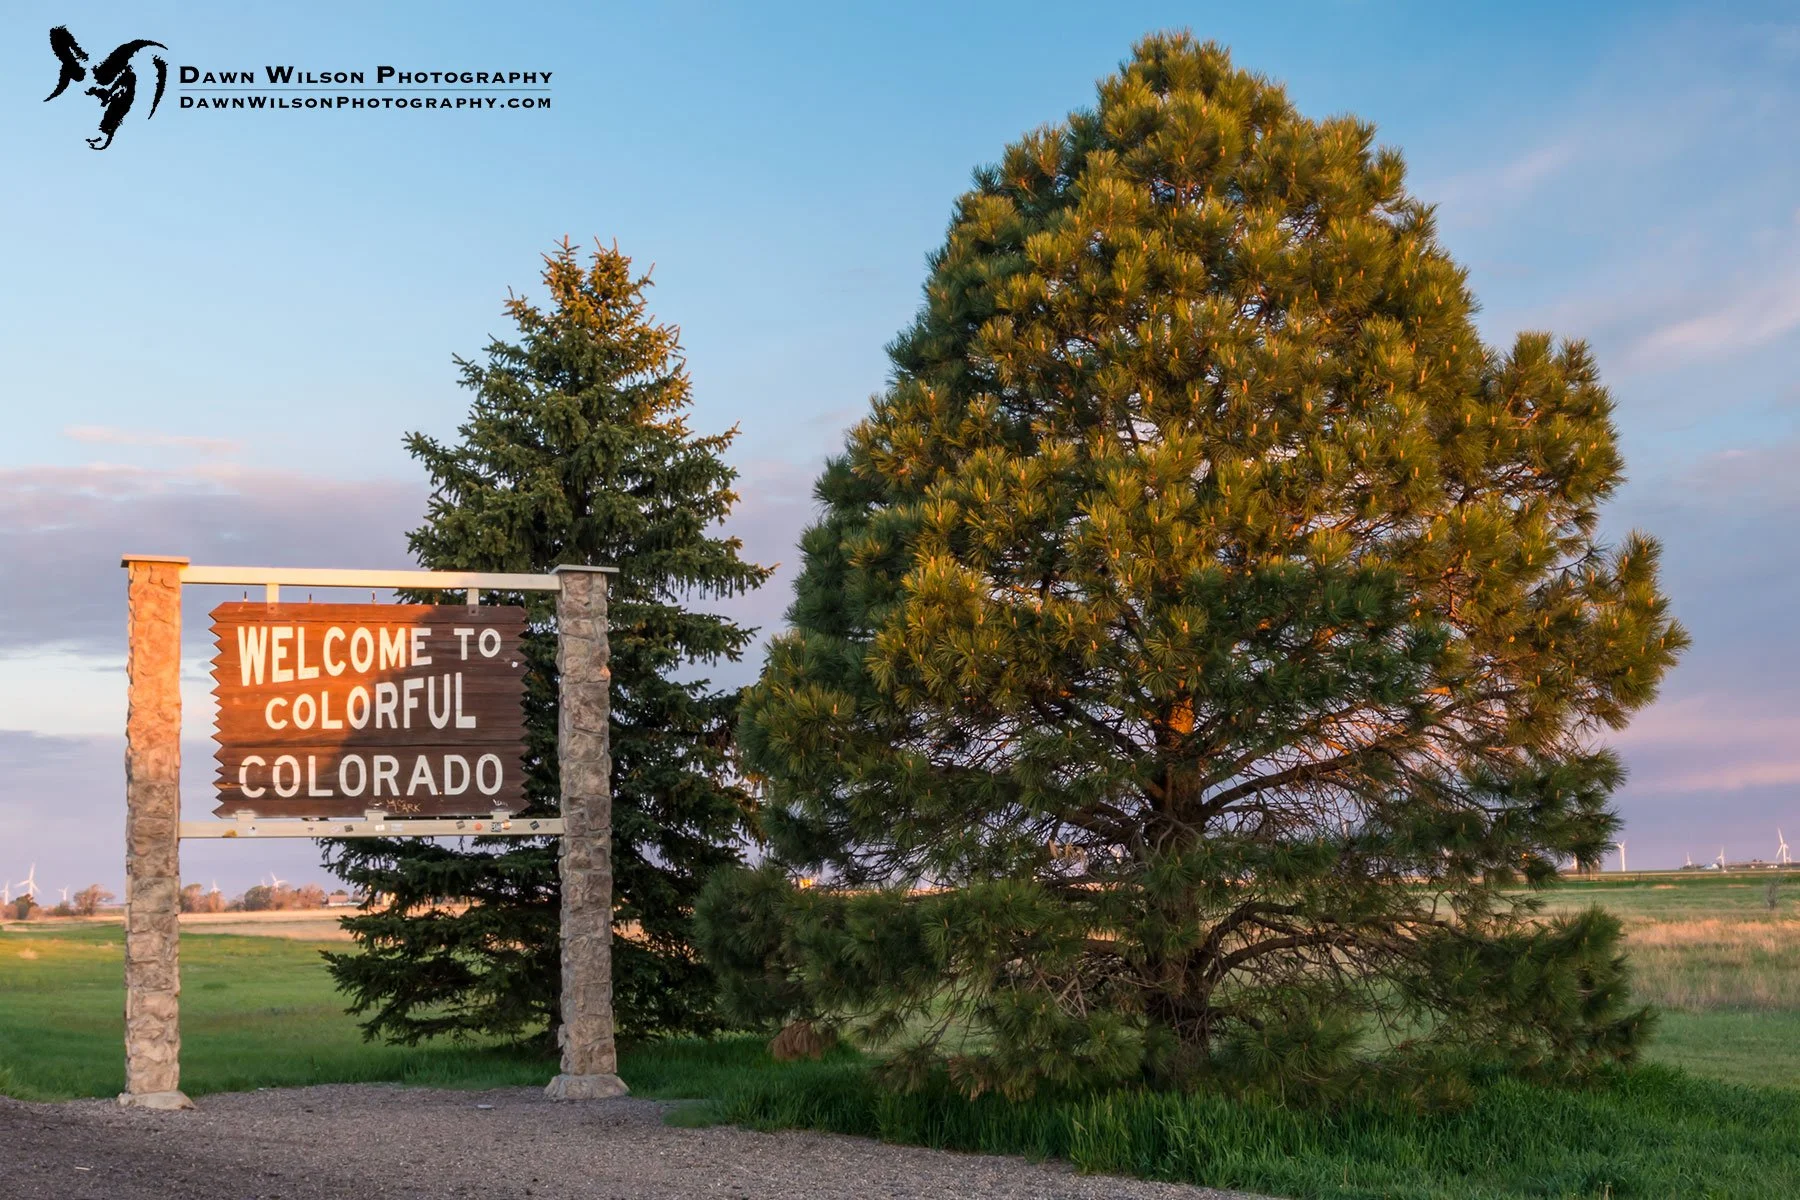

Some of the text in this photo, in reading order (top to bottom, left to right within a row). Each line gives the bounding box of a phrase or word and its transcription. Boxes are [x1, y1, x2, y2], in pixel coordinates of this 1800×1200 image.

[238, 626, 501, 686] WELCOME TO
[265, 672, 476, 730] COLORFUL
[238, 753, 503, 798] COLORADO
